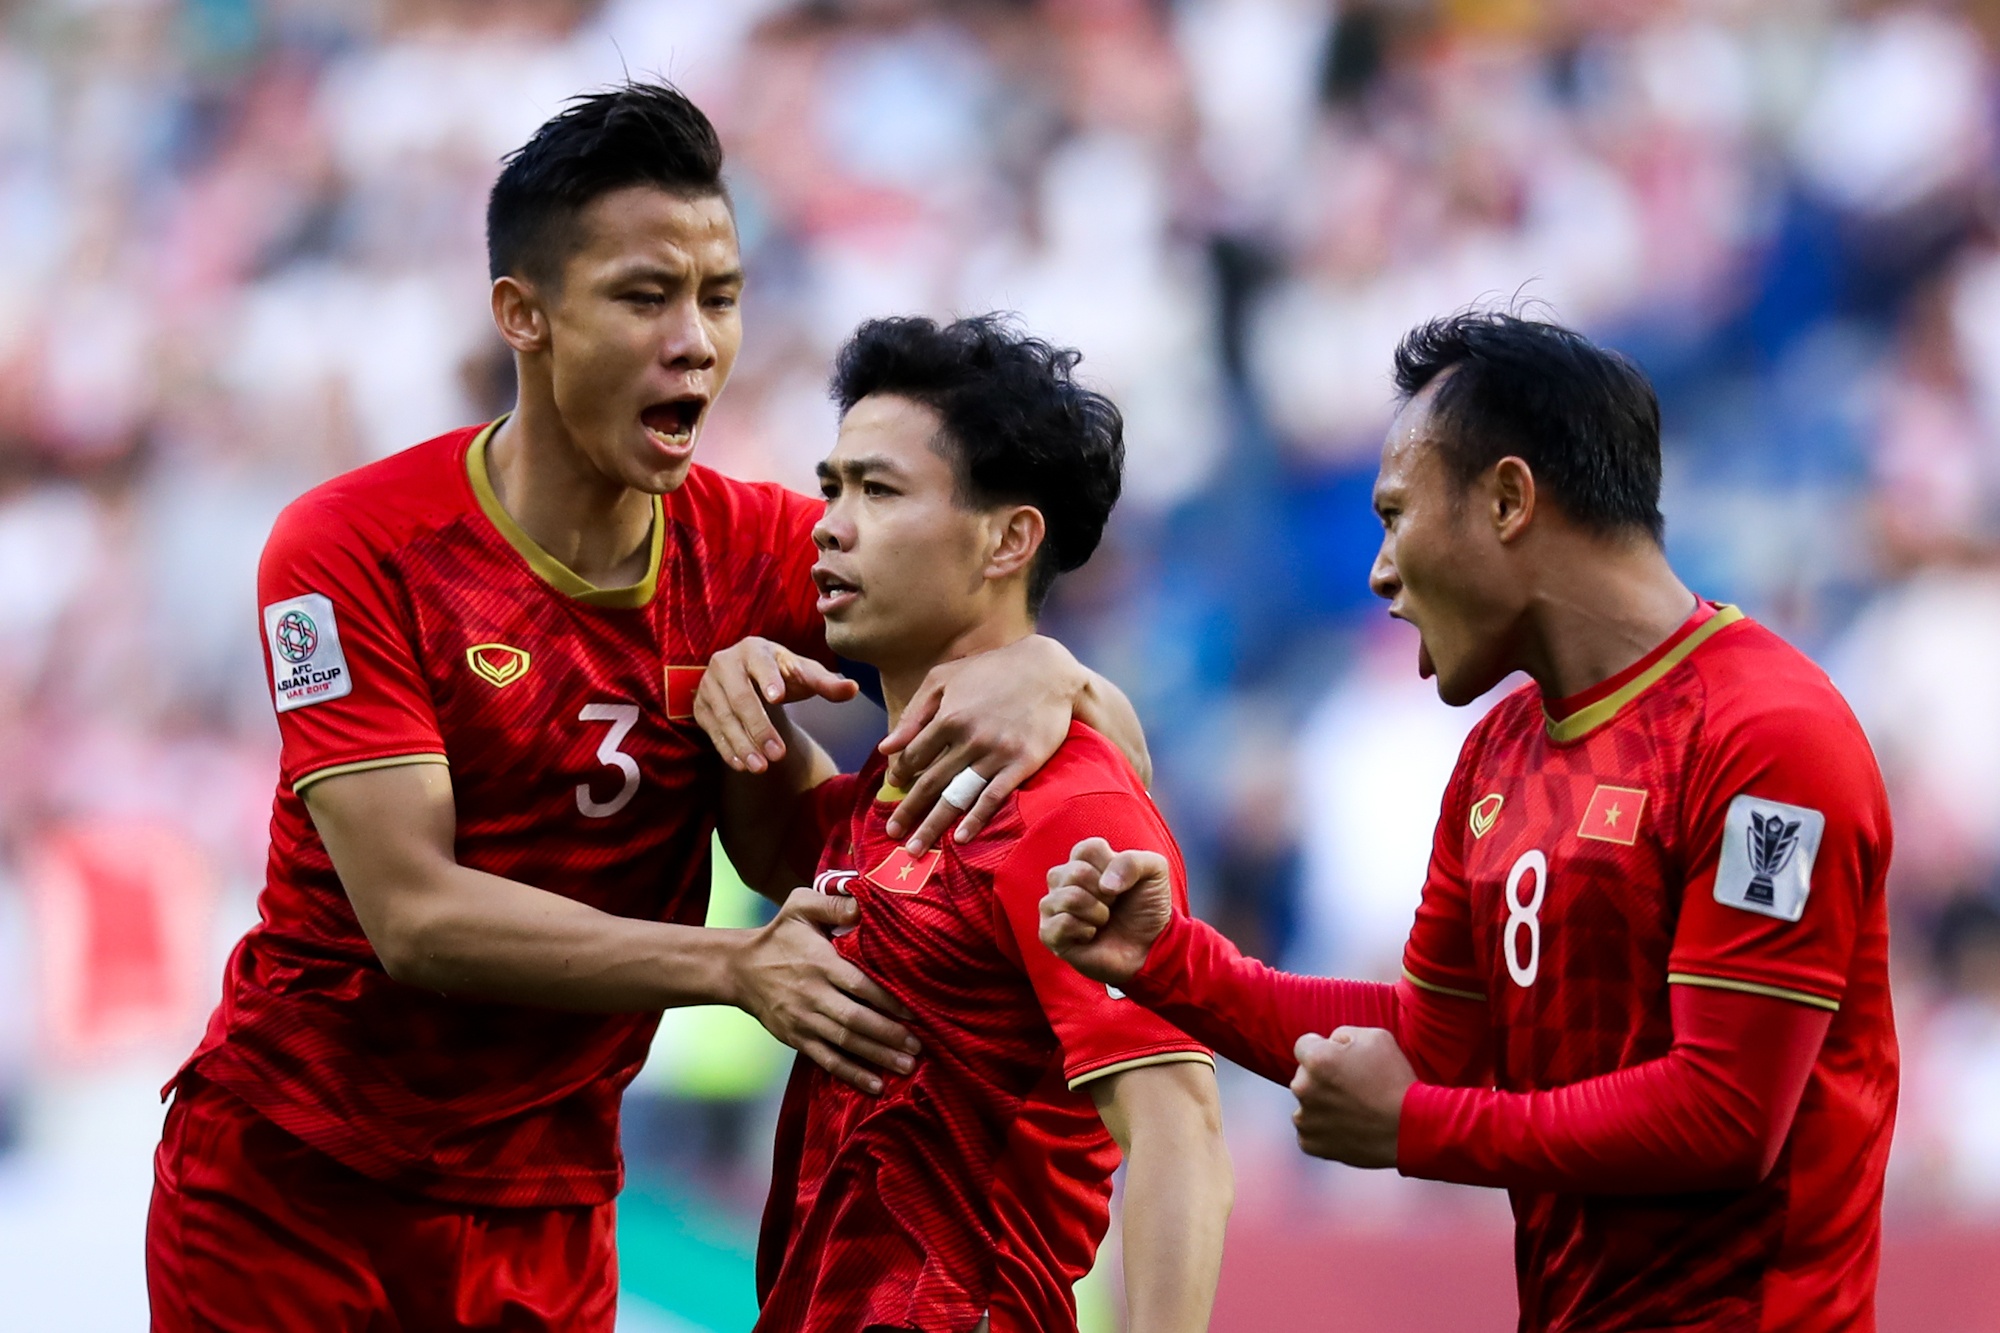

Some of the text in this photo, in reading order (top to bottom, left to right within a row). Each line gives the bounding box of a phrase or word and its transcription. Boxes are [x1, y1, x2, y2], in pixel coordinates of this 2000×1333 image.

[292, 663, 312, 676] AFC
[312, 667, 341, 683] CUP
[286, 688, 303, 699] UAE
[576, 703, 641, 818] 3
[1504, 849, 1547, 987] 8
